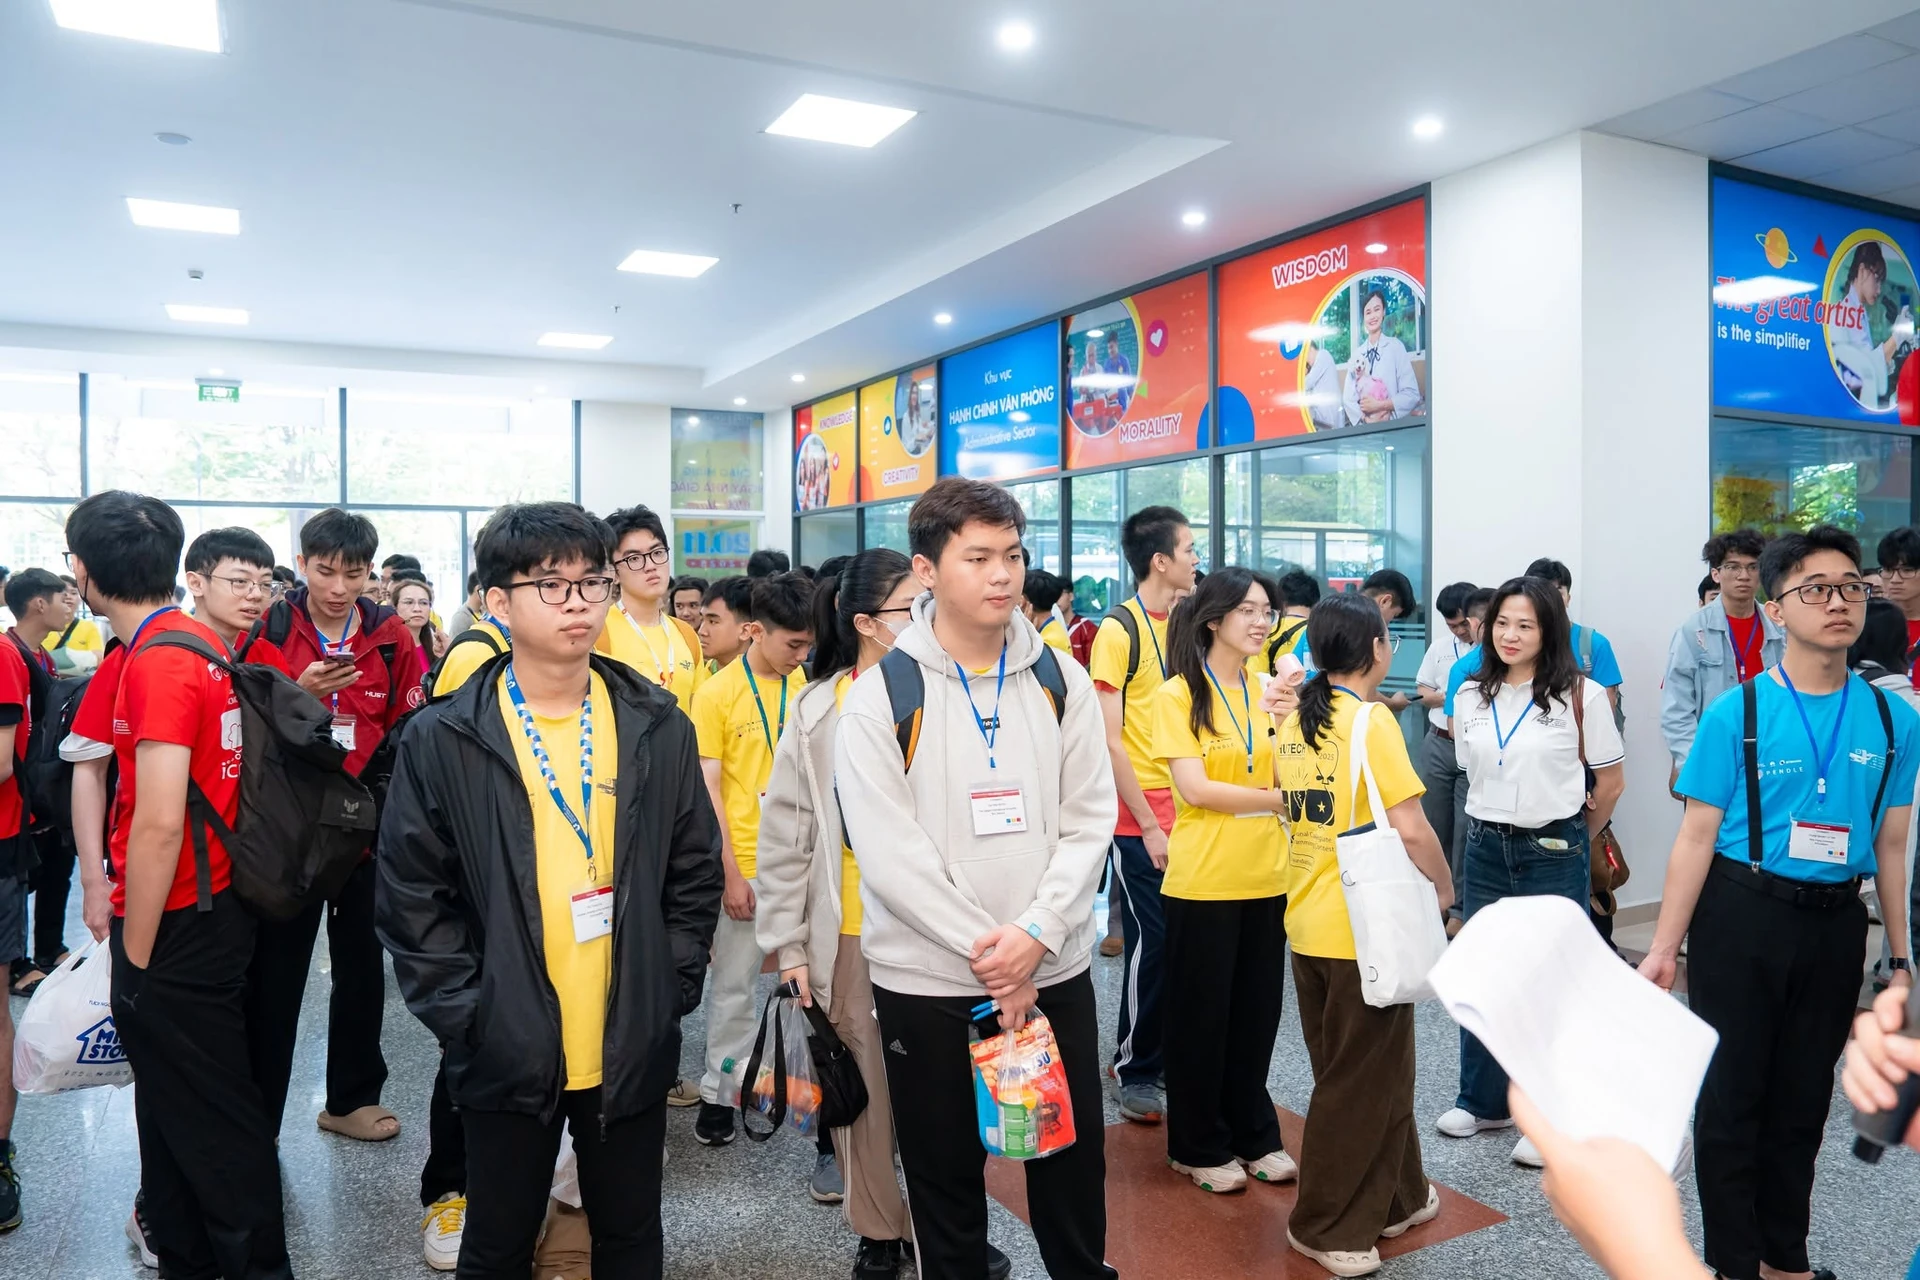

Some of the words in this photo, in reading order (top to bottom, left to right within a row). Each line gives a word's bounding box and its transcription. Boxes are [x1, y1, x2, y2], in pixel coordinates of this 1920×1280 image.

[1273, 246, 1347, 288] WISDOM
[1756, 293, 1810, 324] great
[1814, 298, 1864, 330] artist
[1717, 322, 1728, 339] is
[1731, 325, 1752, 342] the
[1755, 328, 1811, 351] simplifier
[984, 370, 997, 385] Khu
[1020, 385, 1054, 408] PHÒNG
[1013, 426, 1036, 440] Sector
[1119, 413, 1182, 443] MORALITY
[883, 466, 919, 485] CREATIVITY
[365, 690, 387, 699] HUST
[1766, 766, 1803, 776] PENDLE
